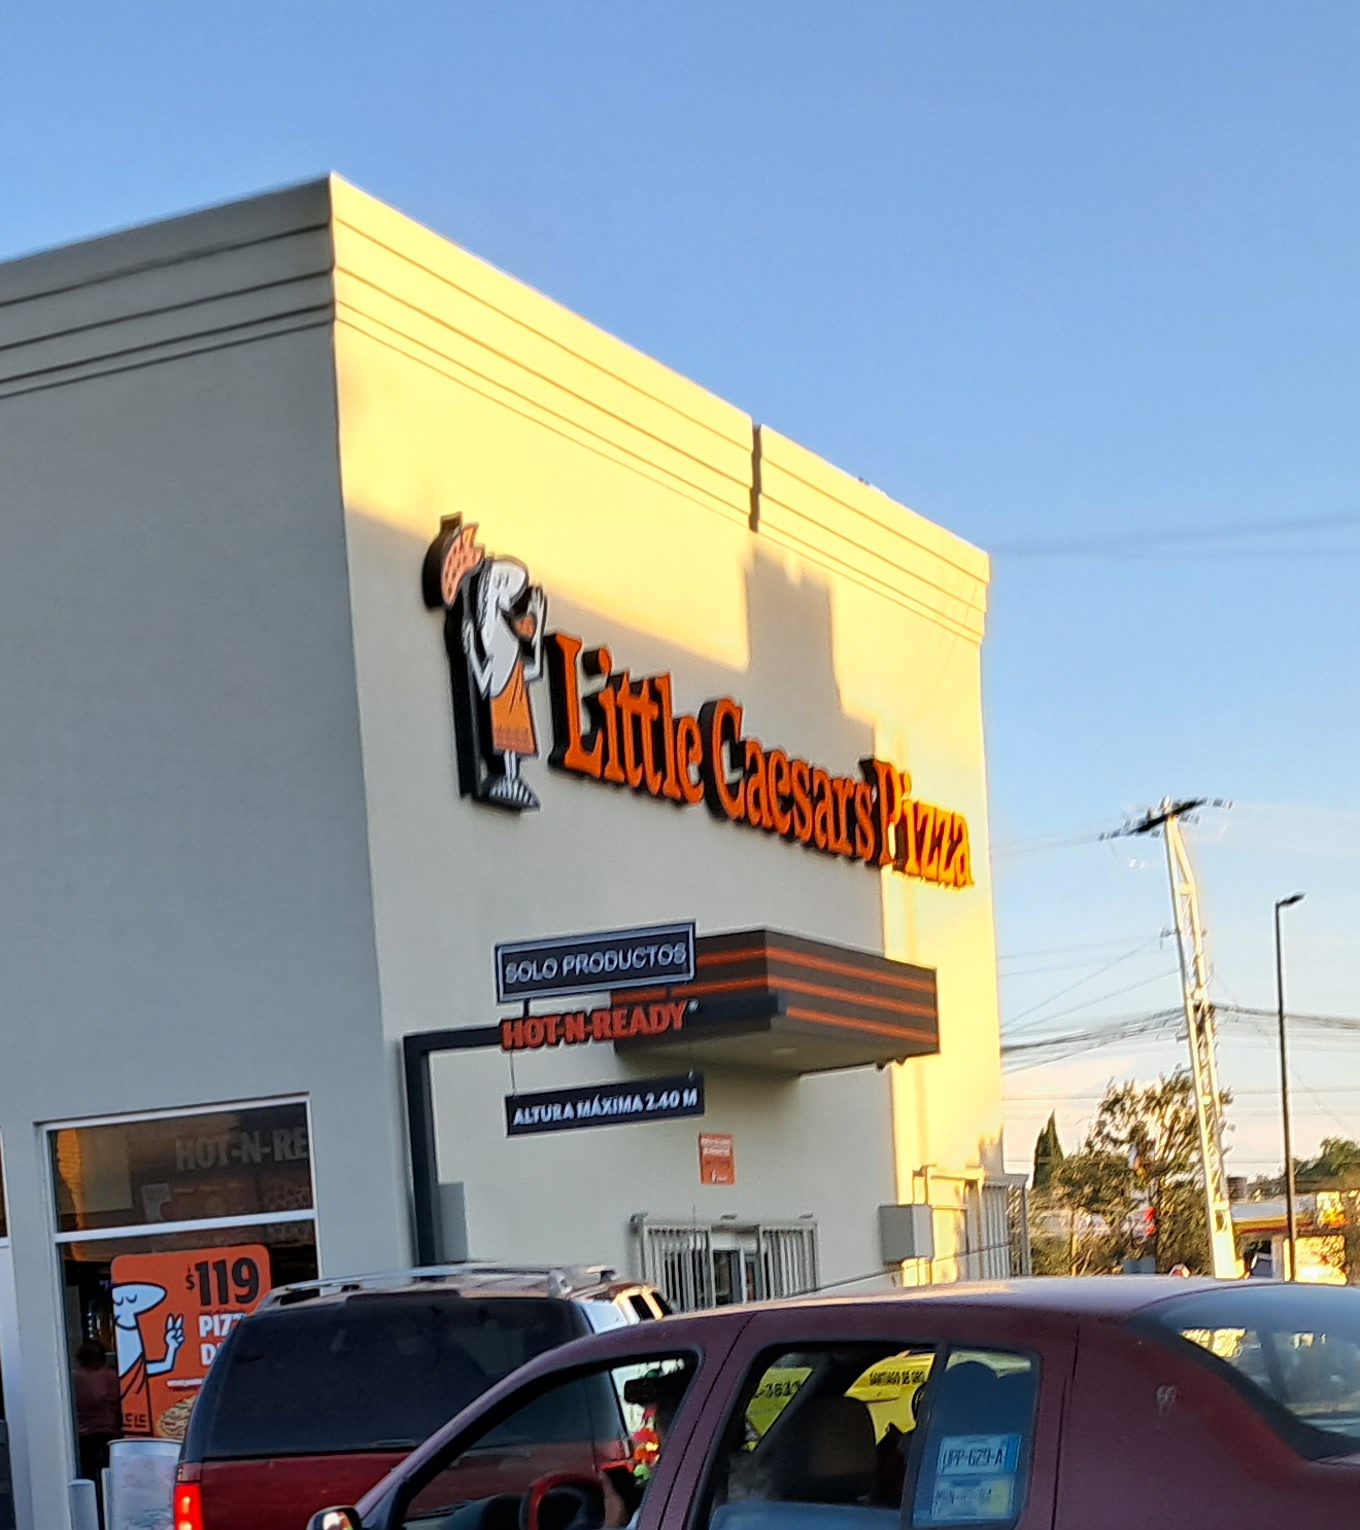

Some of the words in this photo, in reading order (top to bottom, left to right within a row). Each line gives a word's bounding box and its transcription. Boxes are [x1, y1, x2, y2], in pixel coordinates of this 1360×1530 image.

[543, 631, 705, 806] Little
[700, 696, 877, 866] Caesars
[860, 757, 975, 890] Pizza
[505, 957, 558, 984] SOLO
[562, 942, 687, 977] PRODUCTOS
[501, 1000, 688, 1050] HOT-N-READY
[512, 1102, 575, 1128] ALTURA
[576, 1093, 644, 1120] MÁXIMA
[645, 1089, 680, 1112] 2.40
[682, 1087, 698, 1107] M
[185, 1256, 260, 1307] $119
[200, 1342, 224, 1366] D
